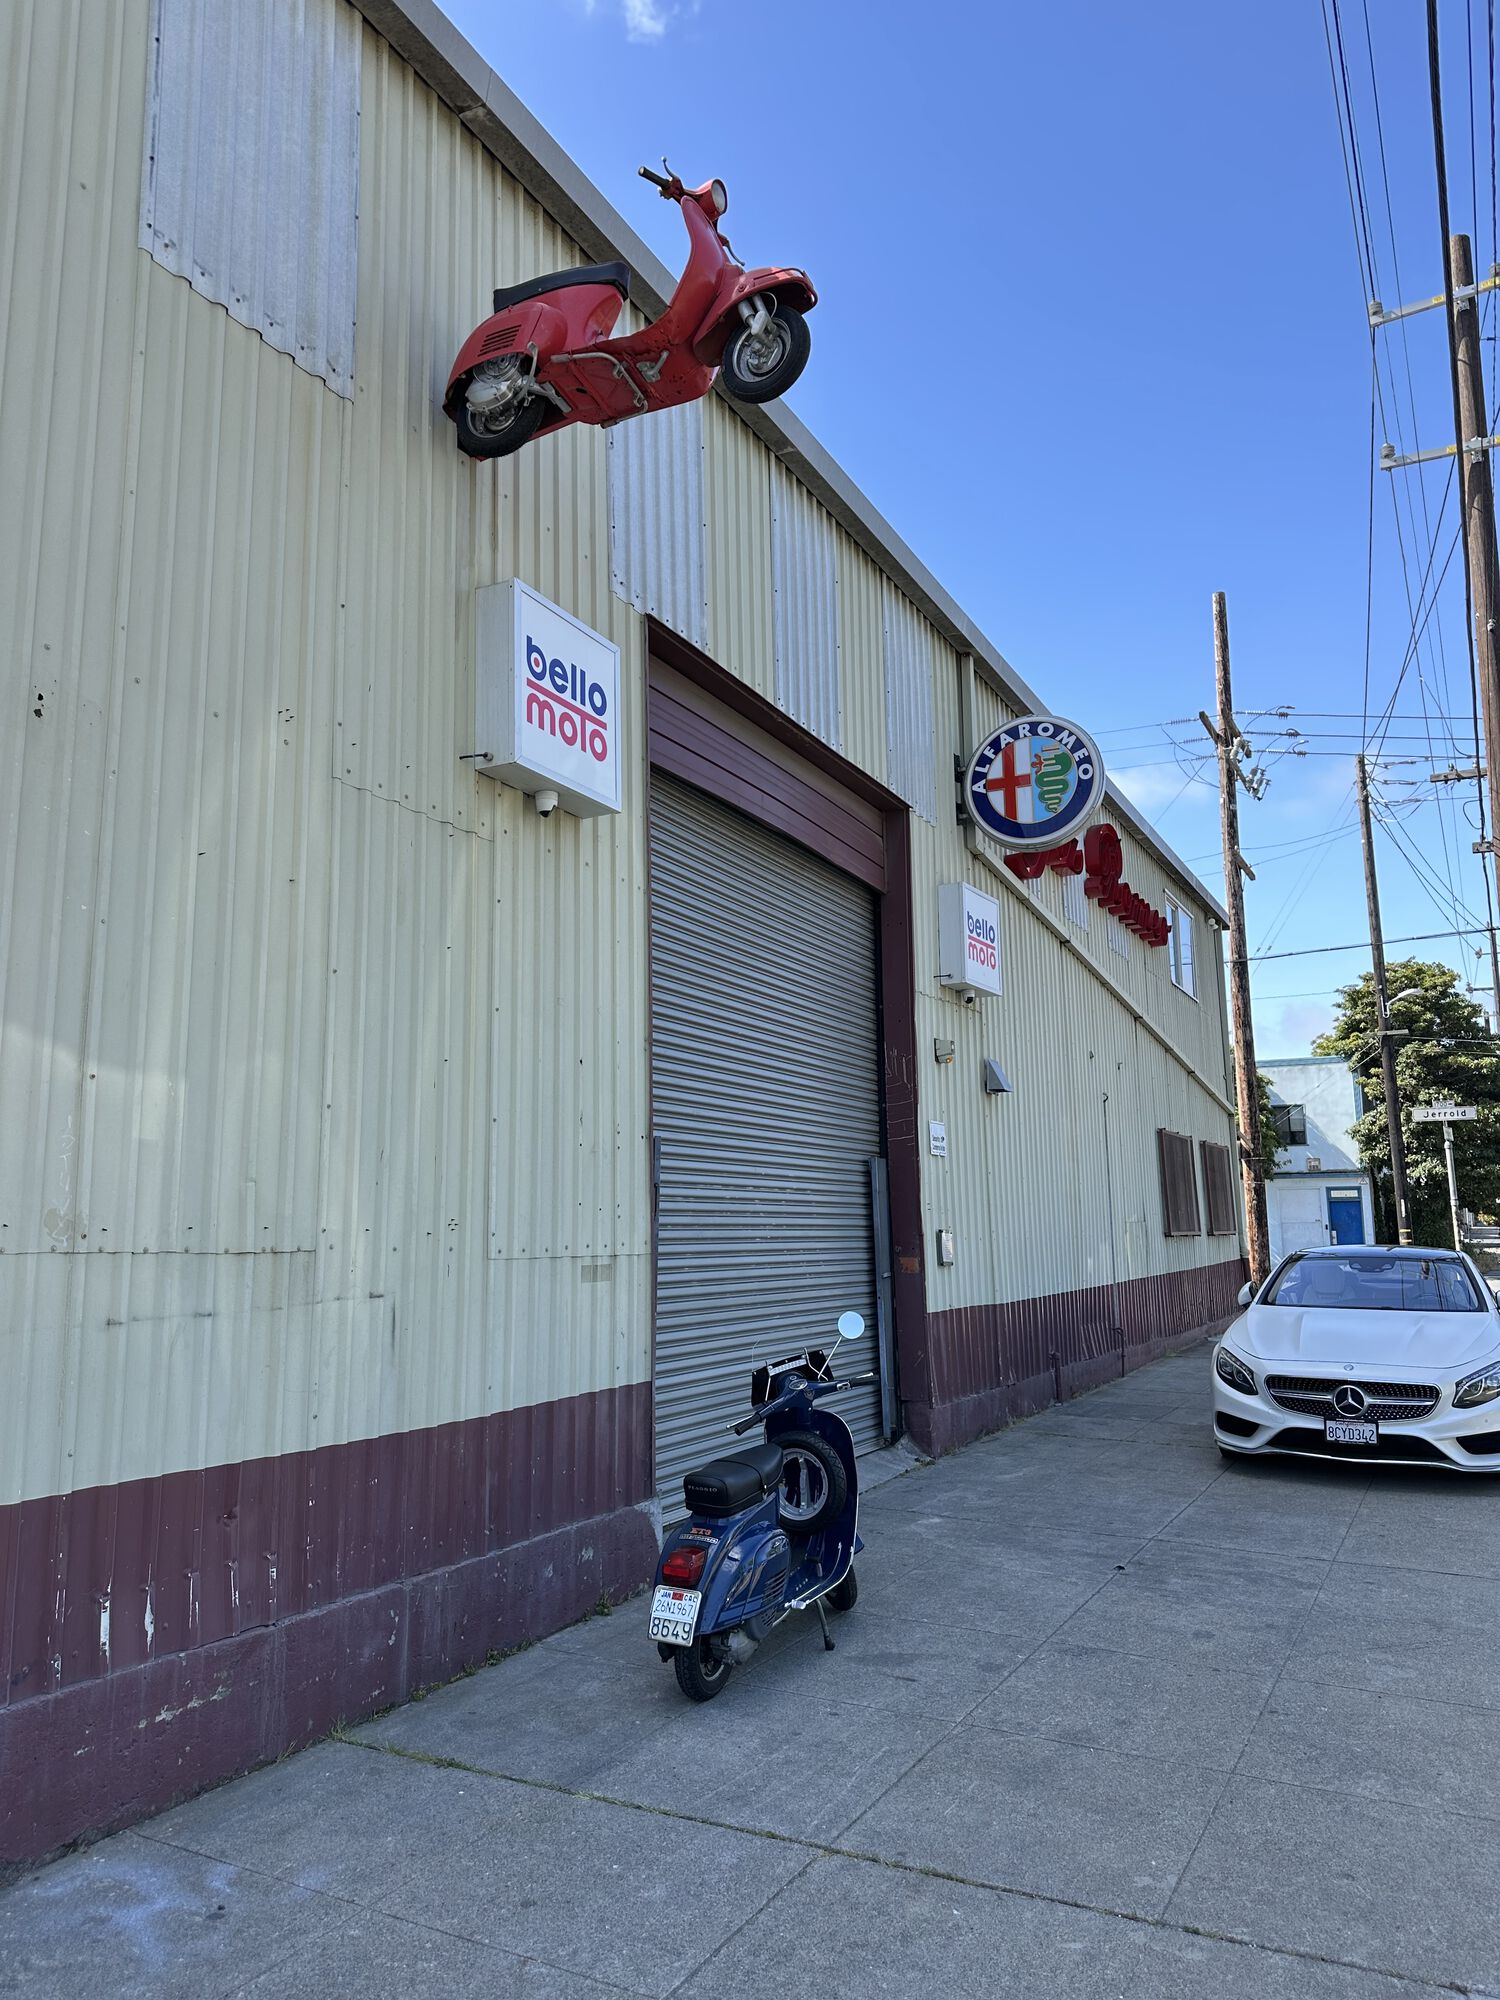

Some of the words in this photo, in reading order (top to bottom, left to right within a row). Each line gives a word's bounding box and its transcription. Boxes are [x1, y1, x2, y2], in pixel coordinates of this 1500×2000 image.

[526, 635, 607, 716] bello
[972, 733, 1015, 794] ALFA
[1018, 722, 1093, 780] ROMEO
[967, 911, 995, 944] bello
[1423, 1109, 1467, 1118] Jerrold
[1328, 1426, 1375, 1442] 8CYD342
[661, 1591, 672, 1599] JAN
[655, 1599, 694, 1617] 26N1967
[651, 1616, 692, 1641] 8649
